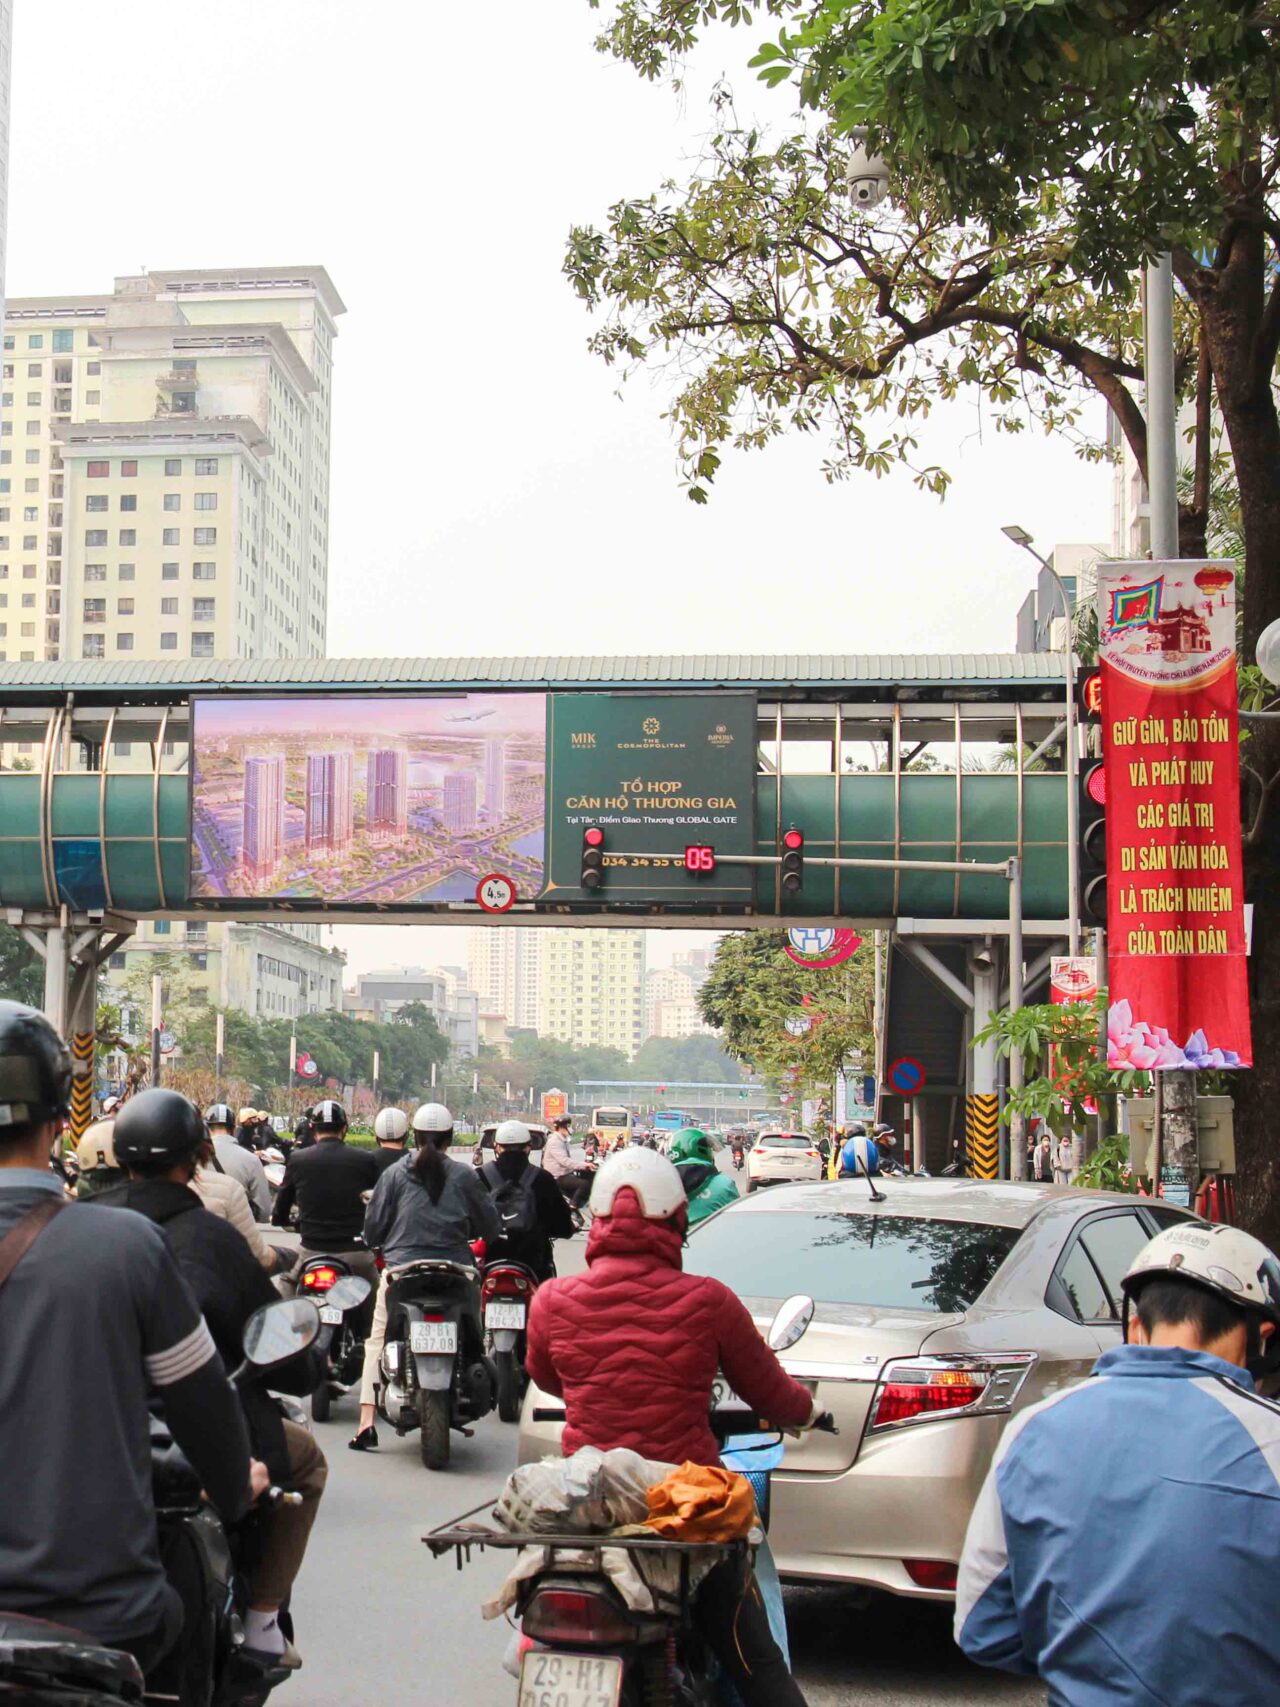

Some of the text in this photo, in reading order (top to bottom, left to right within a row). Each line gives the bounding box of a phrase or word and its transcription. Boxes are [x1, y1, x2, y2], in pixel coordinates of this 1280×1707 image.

[571, 733, 596, 743] MIK
[1113, 716, 1137, 746] GIỮ
[1140, 714, 1169, 746] GÌN,
[1172, 710, 1198, 743] BẢO
[1129, 756, 1214, 787] VÀ PHÁT HUY
[566, 795, 737, 811] CĂN HỘ THƯƠNG GIA
[647, 781, 682, 795] HỢP
[676, 816, 711, 824] GLOBAL
[713, 816, 738, 824] GATE
[1137, 798, 1214, 833] CÁC GIÁ TRỊ
[601, 857, 627, 867] 034
[631, 857, 650, 867] 34
[686, 847, 713, 869] 05
[1121, 838, 1229, 872] DI SẢN VĂN HÓA
[1120, 882, 1233, 917] LÀ TRÁCH NHIỆM
[1128, 923, 1228, 955] CỦA TOÀN DÂN
[533, 1655, 606, 1691] 29-H1
